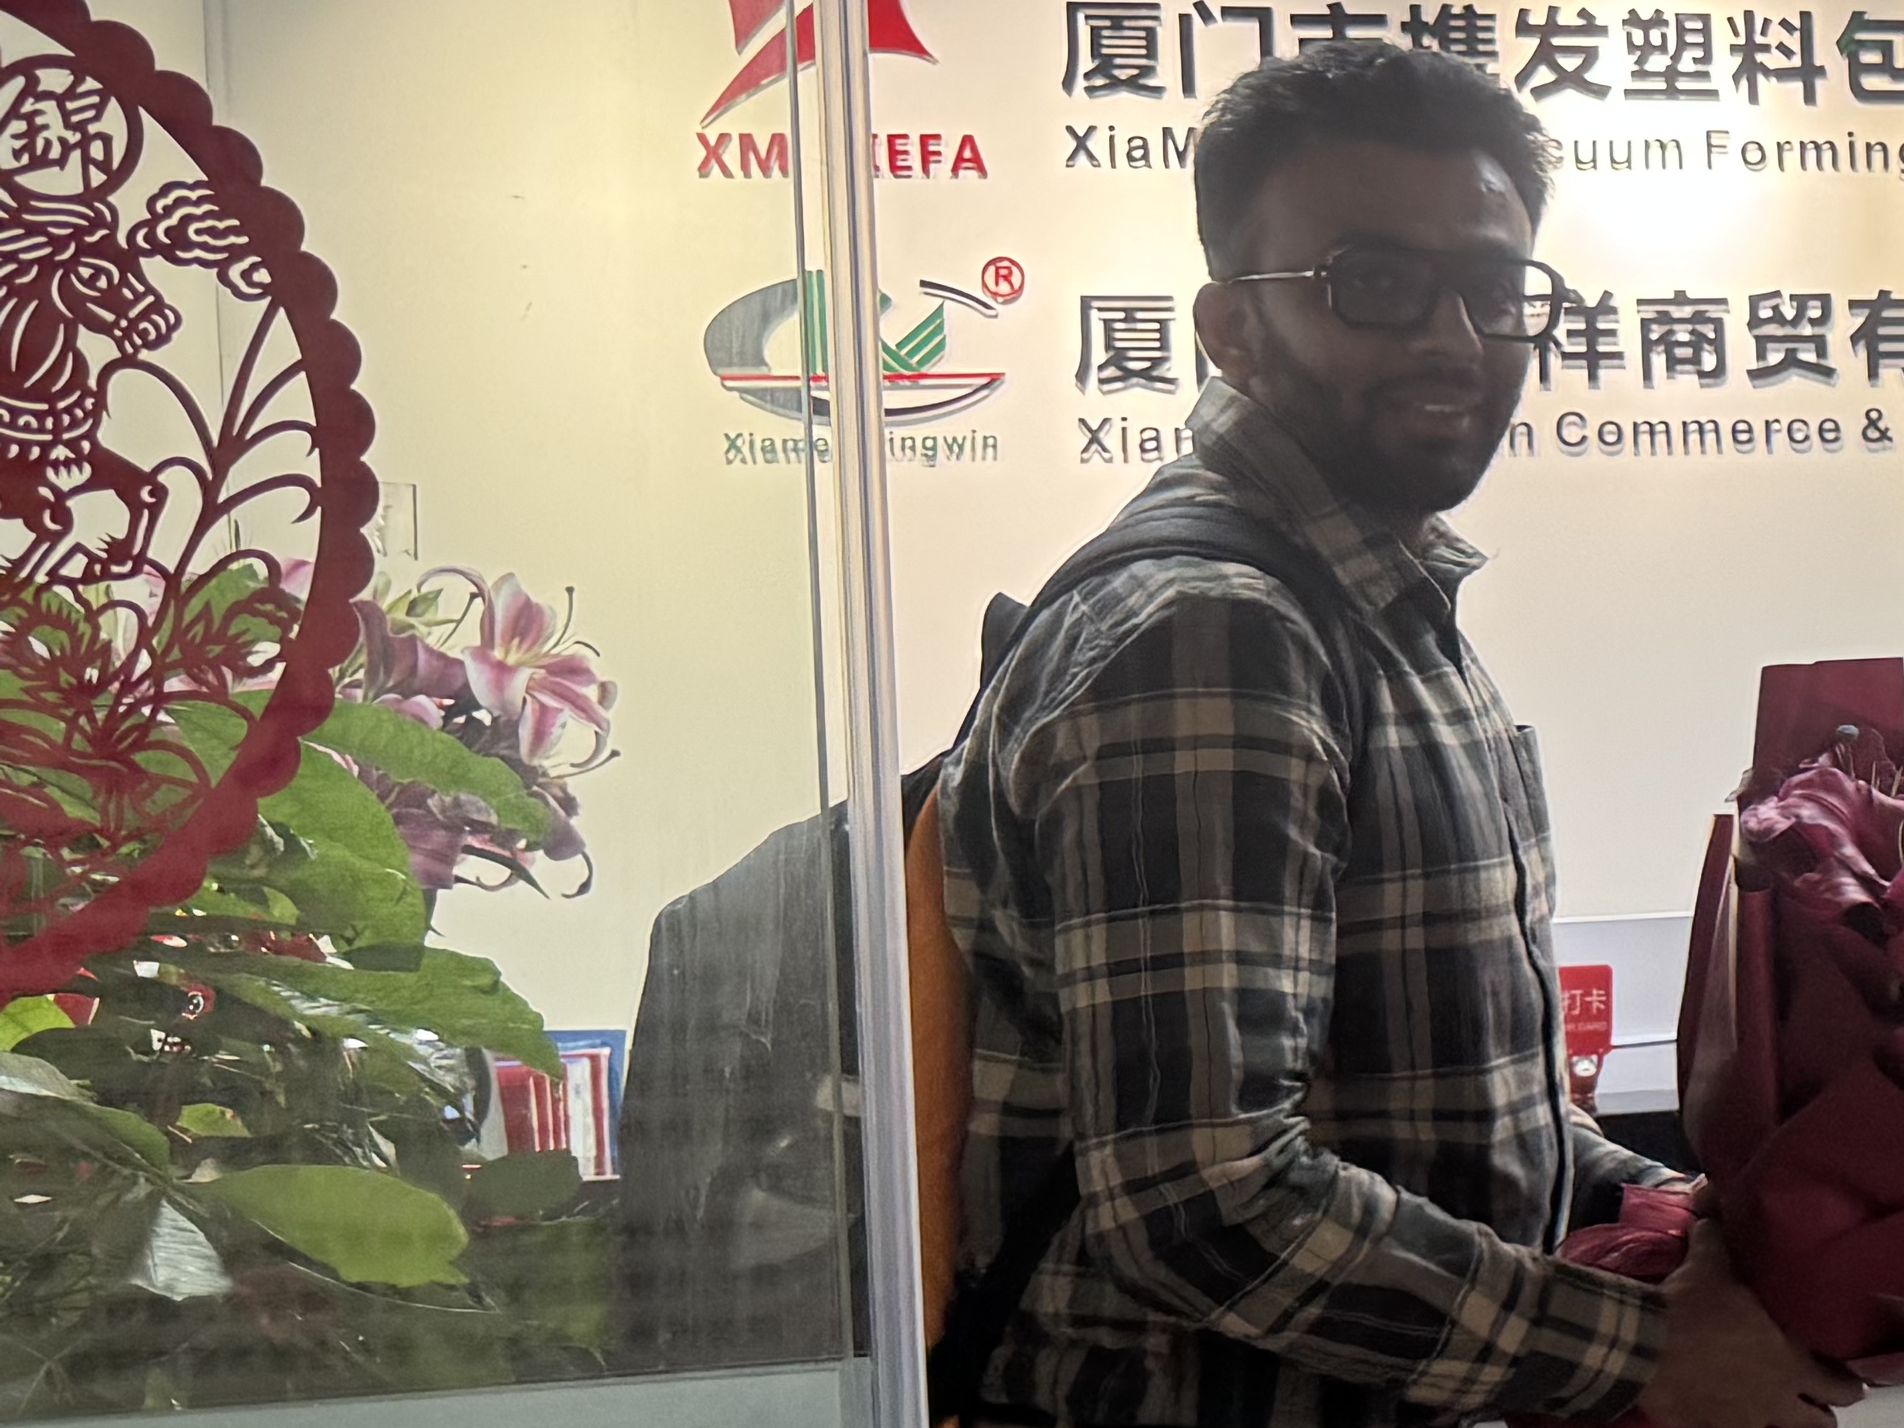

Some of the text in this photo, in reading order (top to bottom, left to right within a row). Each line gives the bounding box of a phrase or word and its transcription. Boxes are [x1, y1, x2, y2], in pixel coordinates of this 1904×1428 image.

[1065, 124, 1197, 170] XiaM
[724, 429, 999, 468] Xiame ingwin
[1555, 411, 1843, 457] Commerce
[1860, 408, 1893, 453] &
